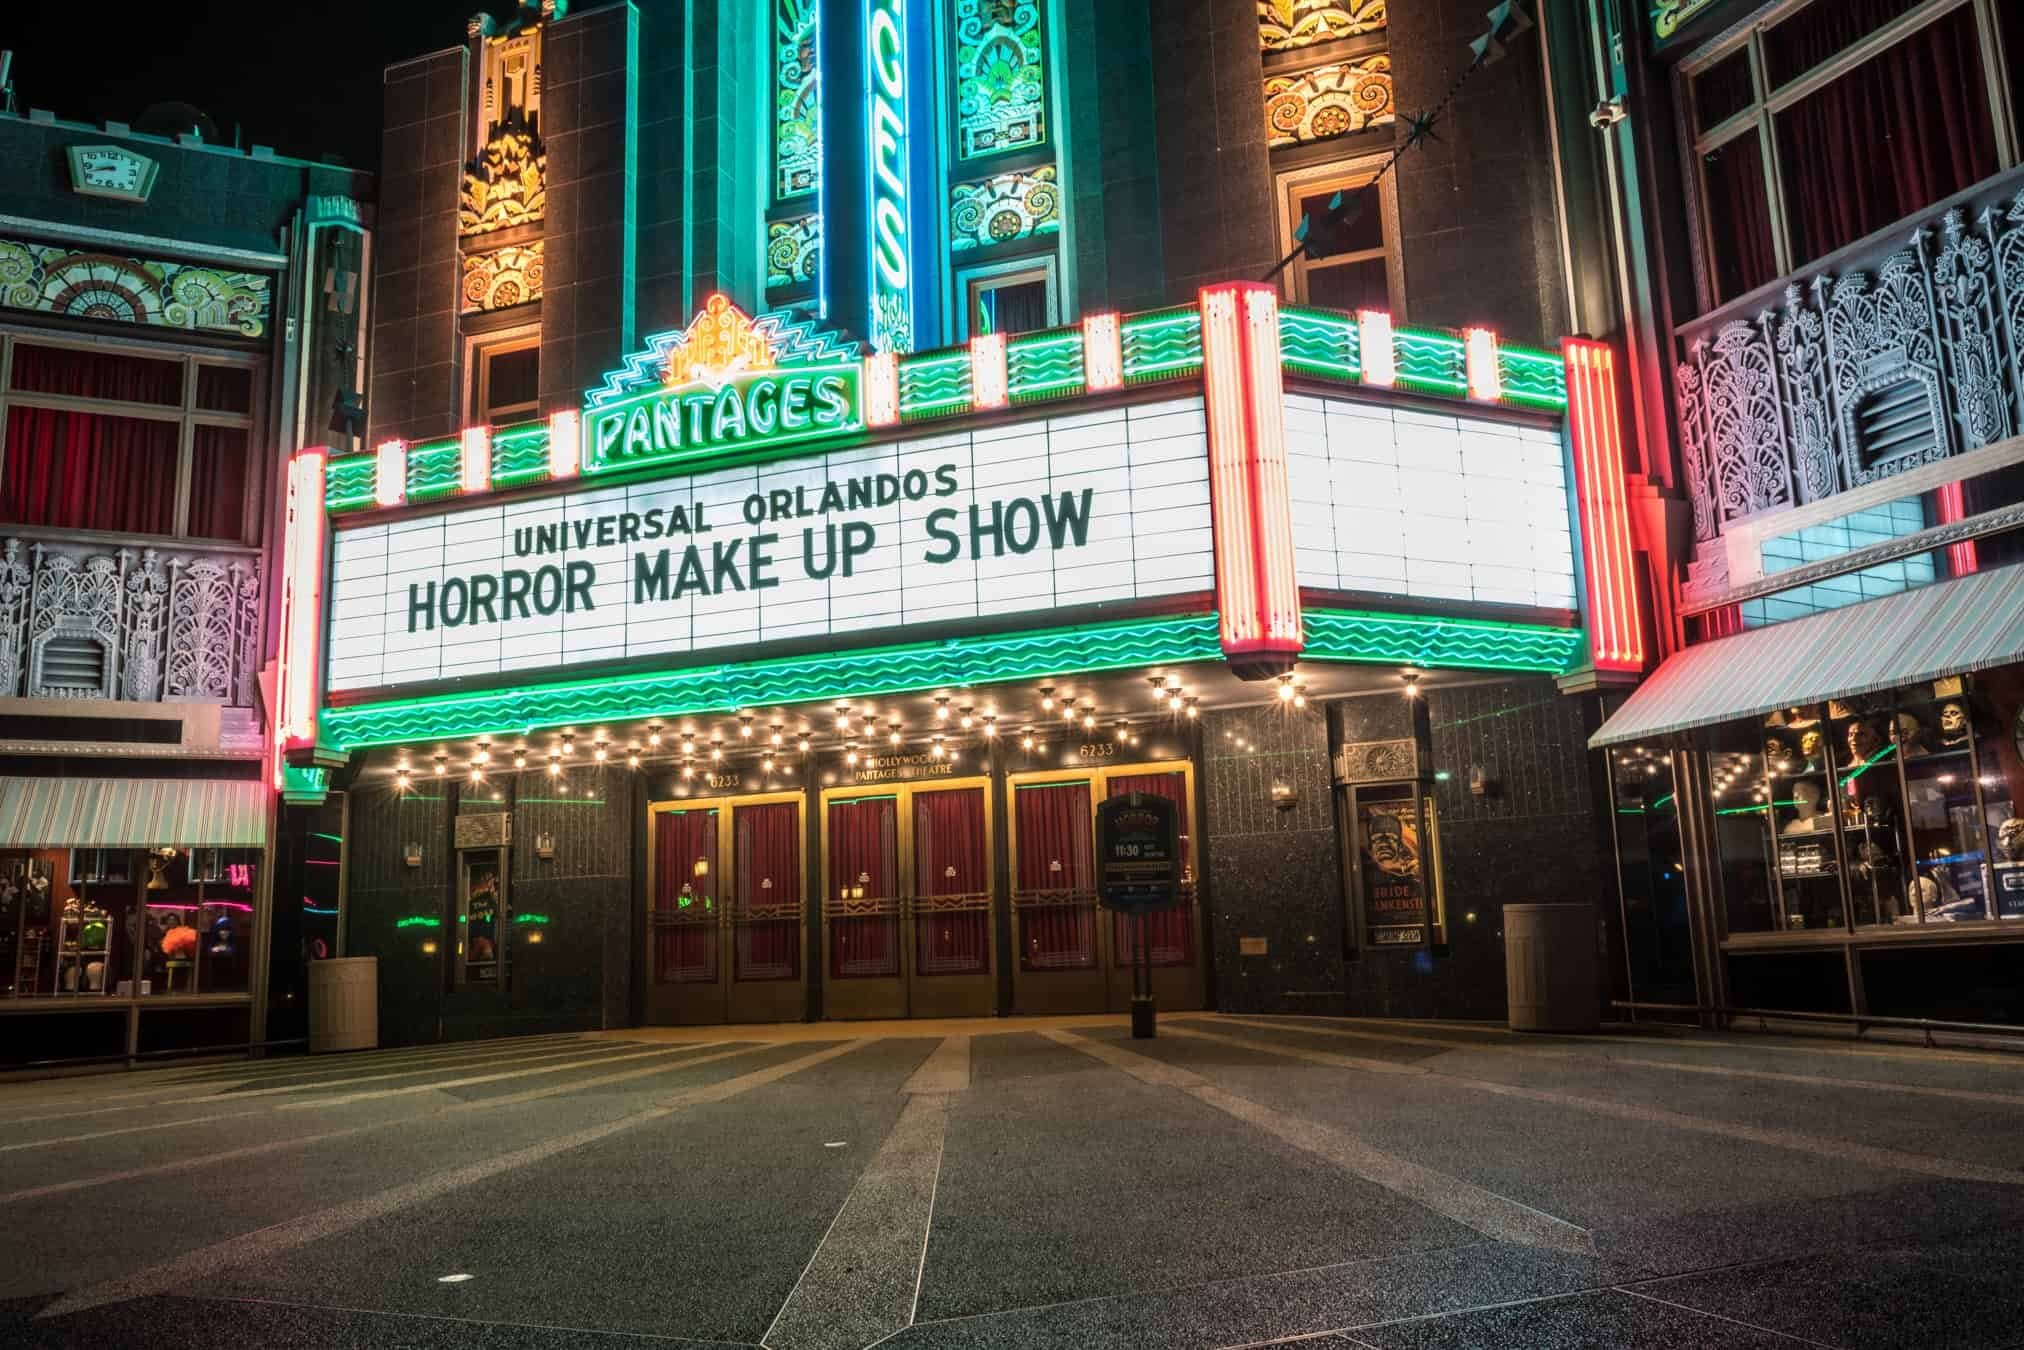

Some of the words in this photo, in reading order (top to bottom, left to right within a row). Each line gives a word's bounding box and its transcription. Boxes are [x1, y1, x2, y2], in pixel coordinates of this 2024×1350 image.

[597, 376, 849, 458] PANTAGES
[514, 502, 713, 558] UNIVERSAL
[743, 463, 959, 525] ORLANDOS
[408, 560, 596, 633] HORROR
[634, 532, 780, 605] MAKE
[802, 520, 877, 581] UP
[923, 487, 1095, 564] SHOW
[1080, 743, 1113, 758] 6233
[1115, 844, 1140, 858] 11:30
